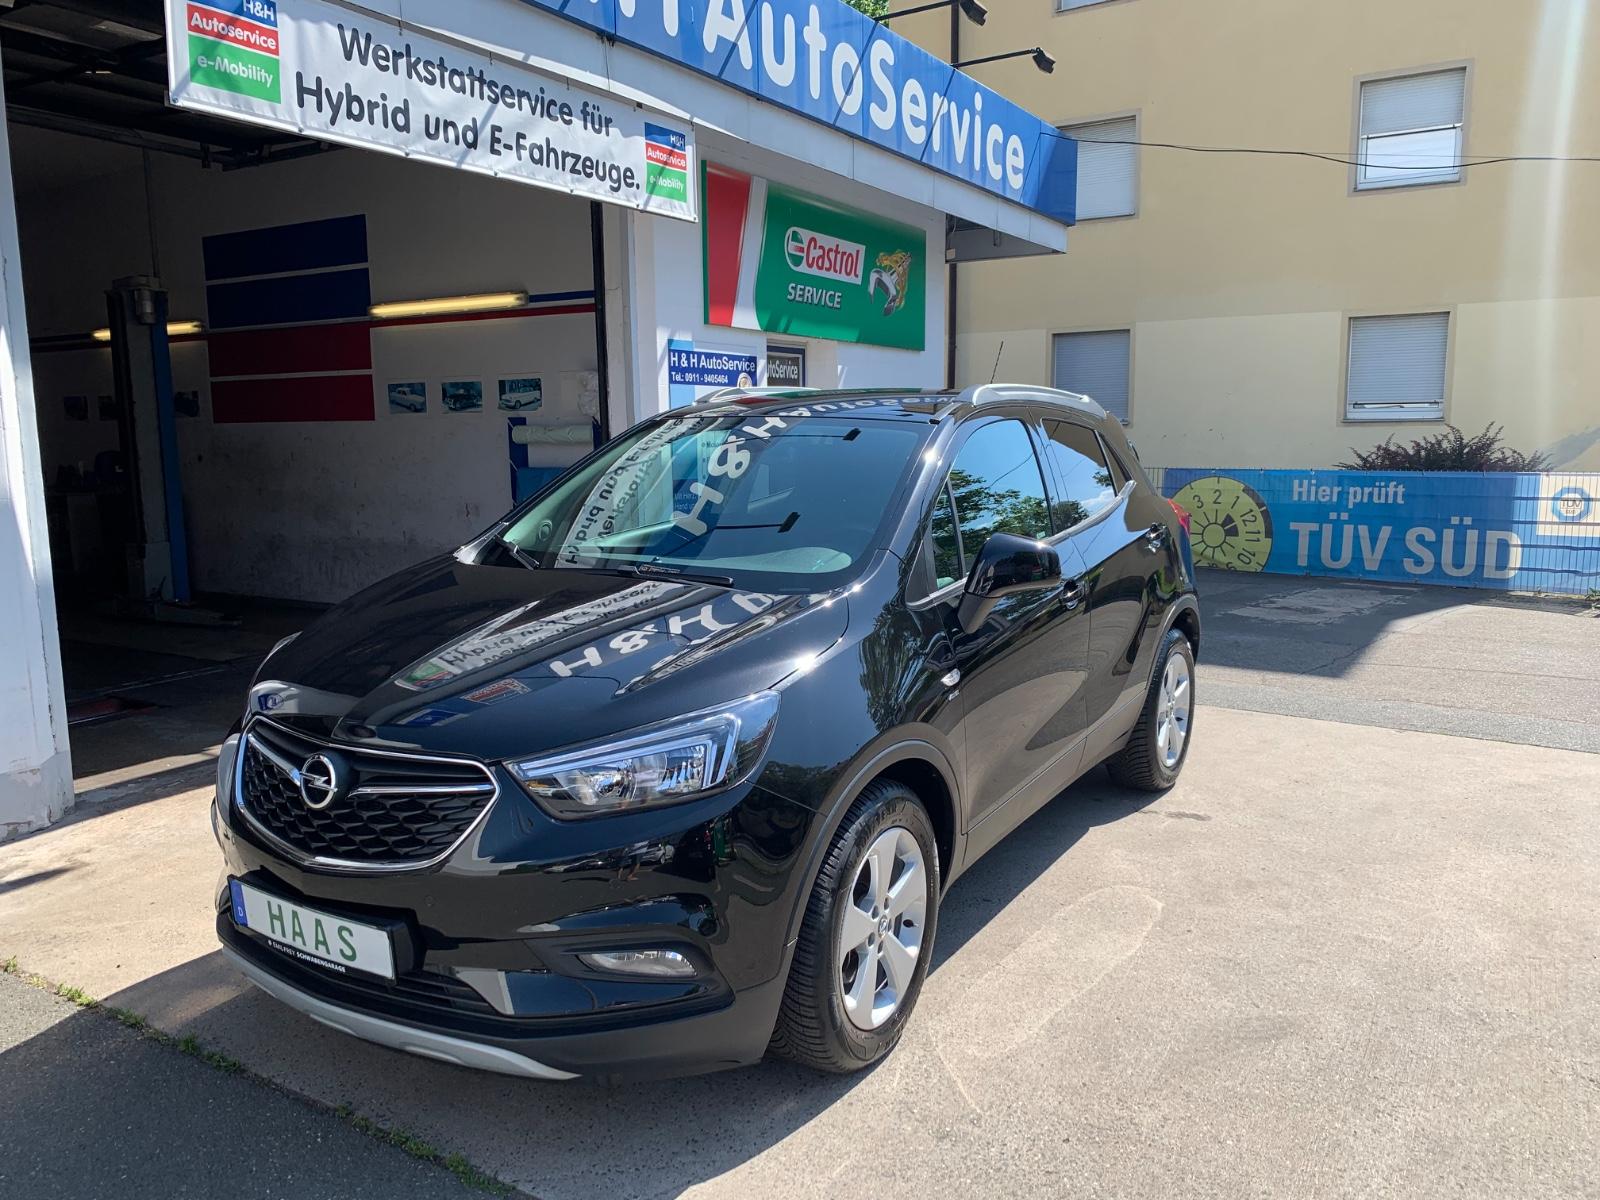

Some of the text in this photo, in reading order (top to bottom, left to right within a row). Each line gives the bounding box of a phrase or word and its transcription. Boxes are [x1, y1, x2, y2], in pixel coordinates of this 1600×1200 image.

[243, 0, 274, 21] H&H
[190, 12, 277, 50] Autoservice
[197, 55, 273, 87] e-Mobility
[337, 23, 613, 137] Werkstattservice für
[703, 0, 1025, 189] AutoService
[295, 71, 640, 192] Hybrid und E-Fahrzeuge.
[670, 134, 684, 147] H&H
[647, 147, 686, 167] Autoservice
[649, 175, 684, 192] e-Mobility
[804, 236, 860, 278] Castrol
[787, 283, 842, 309] SERVICE
[670, 352, 756, 372] H & H AutoService
[685, 373, 700, 383] 0911
[1193, 495, 1204, 509] 3
[1213, 489, 1222, 504] 2
[1231, 496, 1239, 509] 1
[1293, 479, 1405, 508] Hier prüft
[1240, 509, 1257, 527] 12
[1289, 512, 1522, 579] TÜV SÜD
[1237, 548, 1255, 565] 10
[238, 907, 244, 917] D
[267, 900, 357, 962] HAAS
